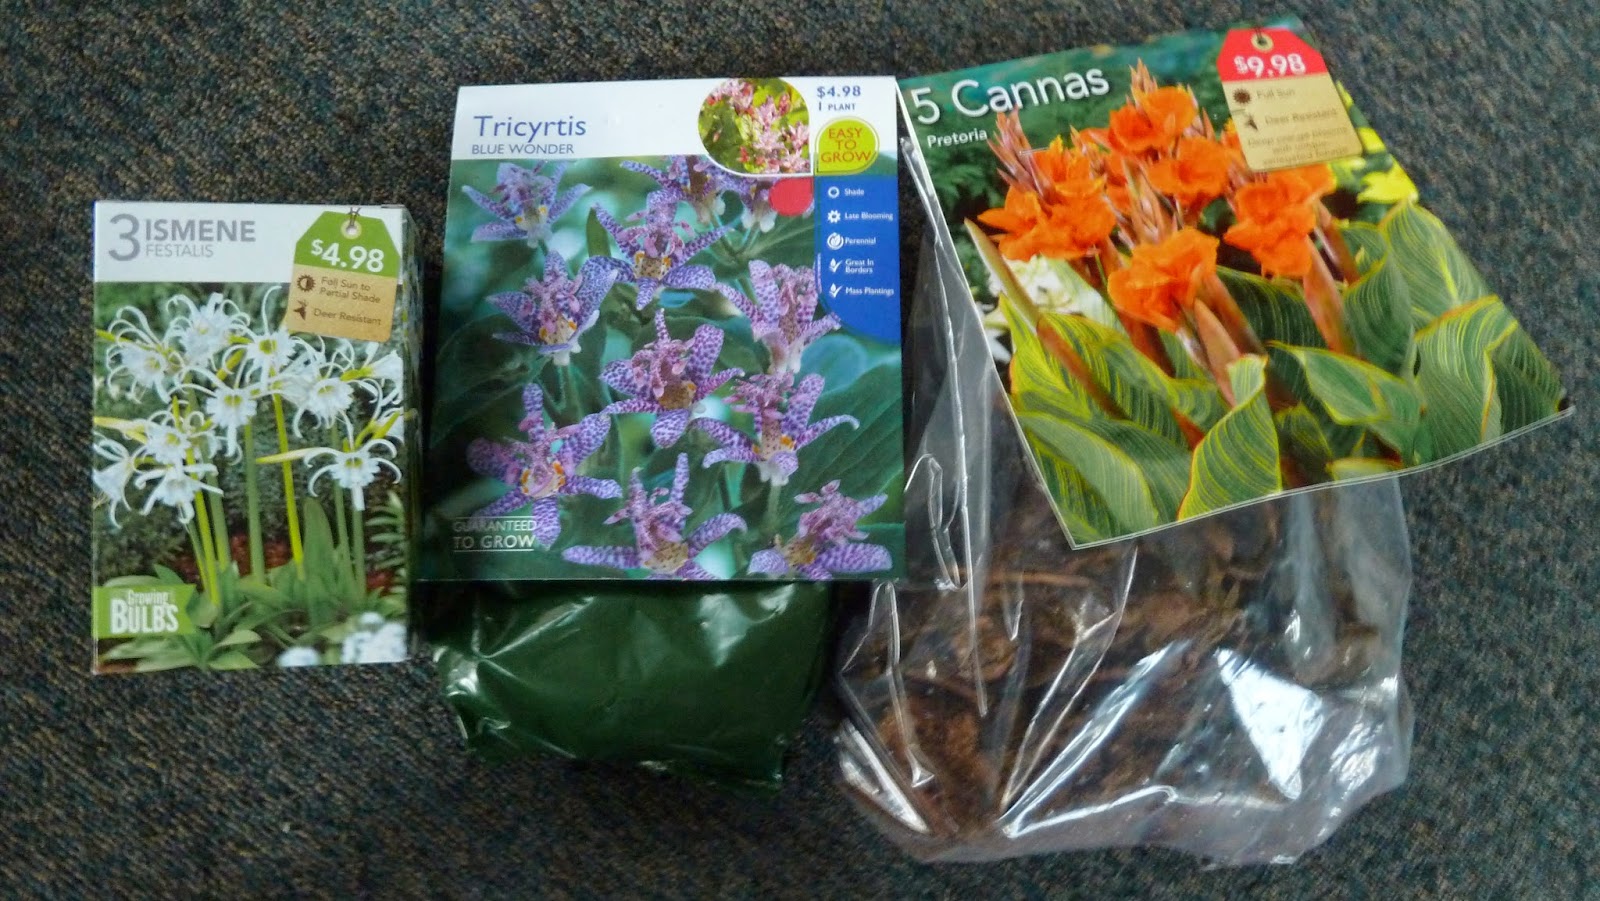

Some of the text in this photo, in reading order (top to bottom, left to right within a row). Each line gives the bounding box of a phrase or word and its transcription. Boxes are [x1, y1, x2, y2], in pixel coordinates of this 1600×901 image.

[1233, 53, 1307, 77] $9.98
[816, 85, 862, 99] $4.98
[910, 67, 1110, 125] 5 Cannas
[828, 102, 857, 111] PLANT
[473, 115, 587, 143] Tricyrtis
[828, 127, 863, 139] EASY
[836, 139, 858, 150] TO
[926, 128, 988, 149] Pretoria
[471, 143, 575, 155] BLUE WONDER
[821, 150, 872, 163] GROW
[844, 188, 865, 196] Shade
[844, 211, 894, 222] Late Blooming
[108, 213, 256, 262] 3 ISMENE
[844, 236, 877, 246] Perennial
[145, 244, 215, 259] FESTALIS
[310, 238, 385, 273] $4.98
[845, 258, 866, 267] Great
[845, 266, 874, 275] Borders
[340, 279, 359, 291] Sun
[360, 283, 372, 292] to
[844, 286, 895, 298] Mass Plantings
[319, 287, 381, 304] Partial Shade
[313, 307, 382, 326] Deer Resistant
[451, 520, 537, 533] GUARANTEED
[452, 534, 536, 550] TO GROW
[127, 588, 170, 606] Growing
[111, 599, 180, 634] BULBS
